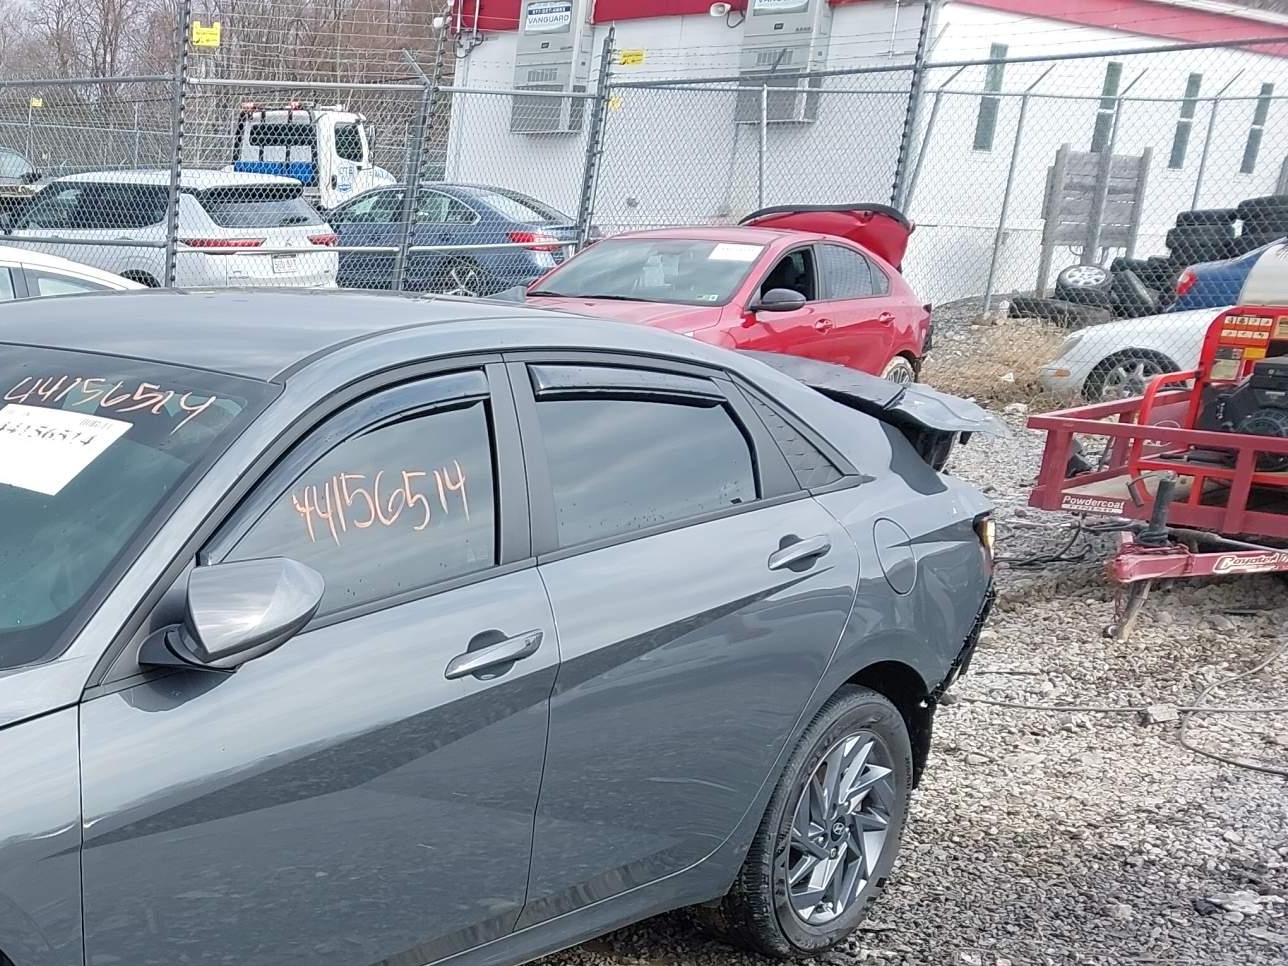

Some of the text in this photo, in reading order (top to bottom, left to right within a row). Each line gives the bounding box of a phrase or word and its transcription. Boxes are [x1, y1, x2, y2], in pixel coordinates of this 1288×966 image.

[528, 14, 569, 25] VANGUARD
[3, 375, 216, 436] 44156514
[292, 459, 470, 547] 44156514
[1062, 495, 1125, 510] Powdercoat
